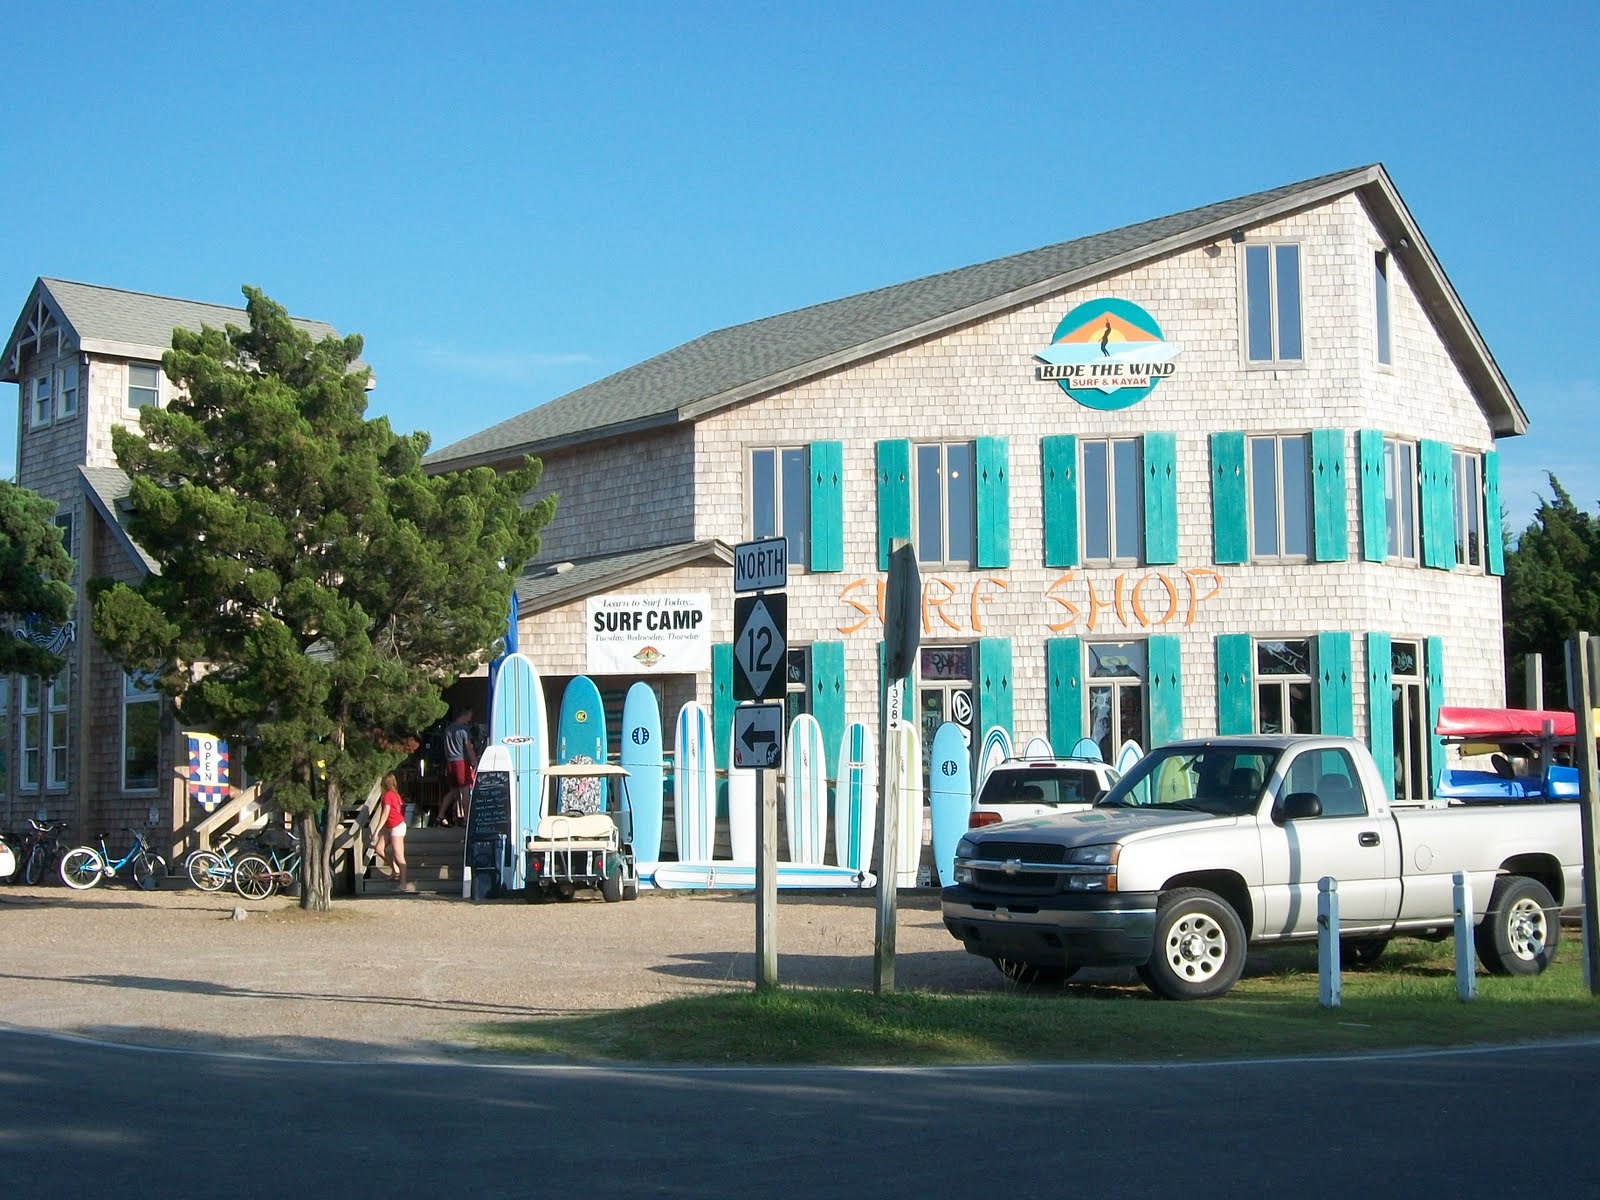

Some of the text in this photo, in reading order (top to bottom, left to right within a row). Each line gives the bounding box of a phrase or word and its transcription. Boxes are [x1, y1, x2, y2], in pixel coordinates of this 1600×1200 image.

[1043, 362, 1176, 378] RIDE THE WIND
[1072, 377, 1148, 387] SURF & KAYAK
[737, 548, 783, 581] NORTH
[603, 599, 629, 608] Learn
[642, 599, 661, 608] Surf
[1044, 568, 1222, 633] SHOP
[594, 610, 703, 632] SURF CAMP
[747, 626, 772, 673] 12
[203, 741, 213, 781] OPEN
